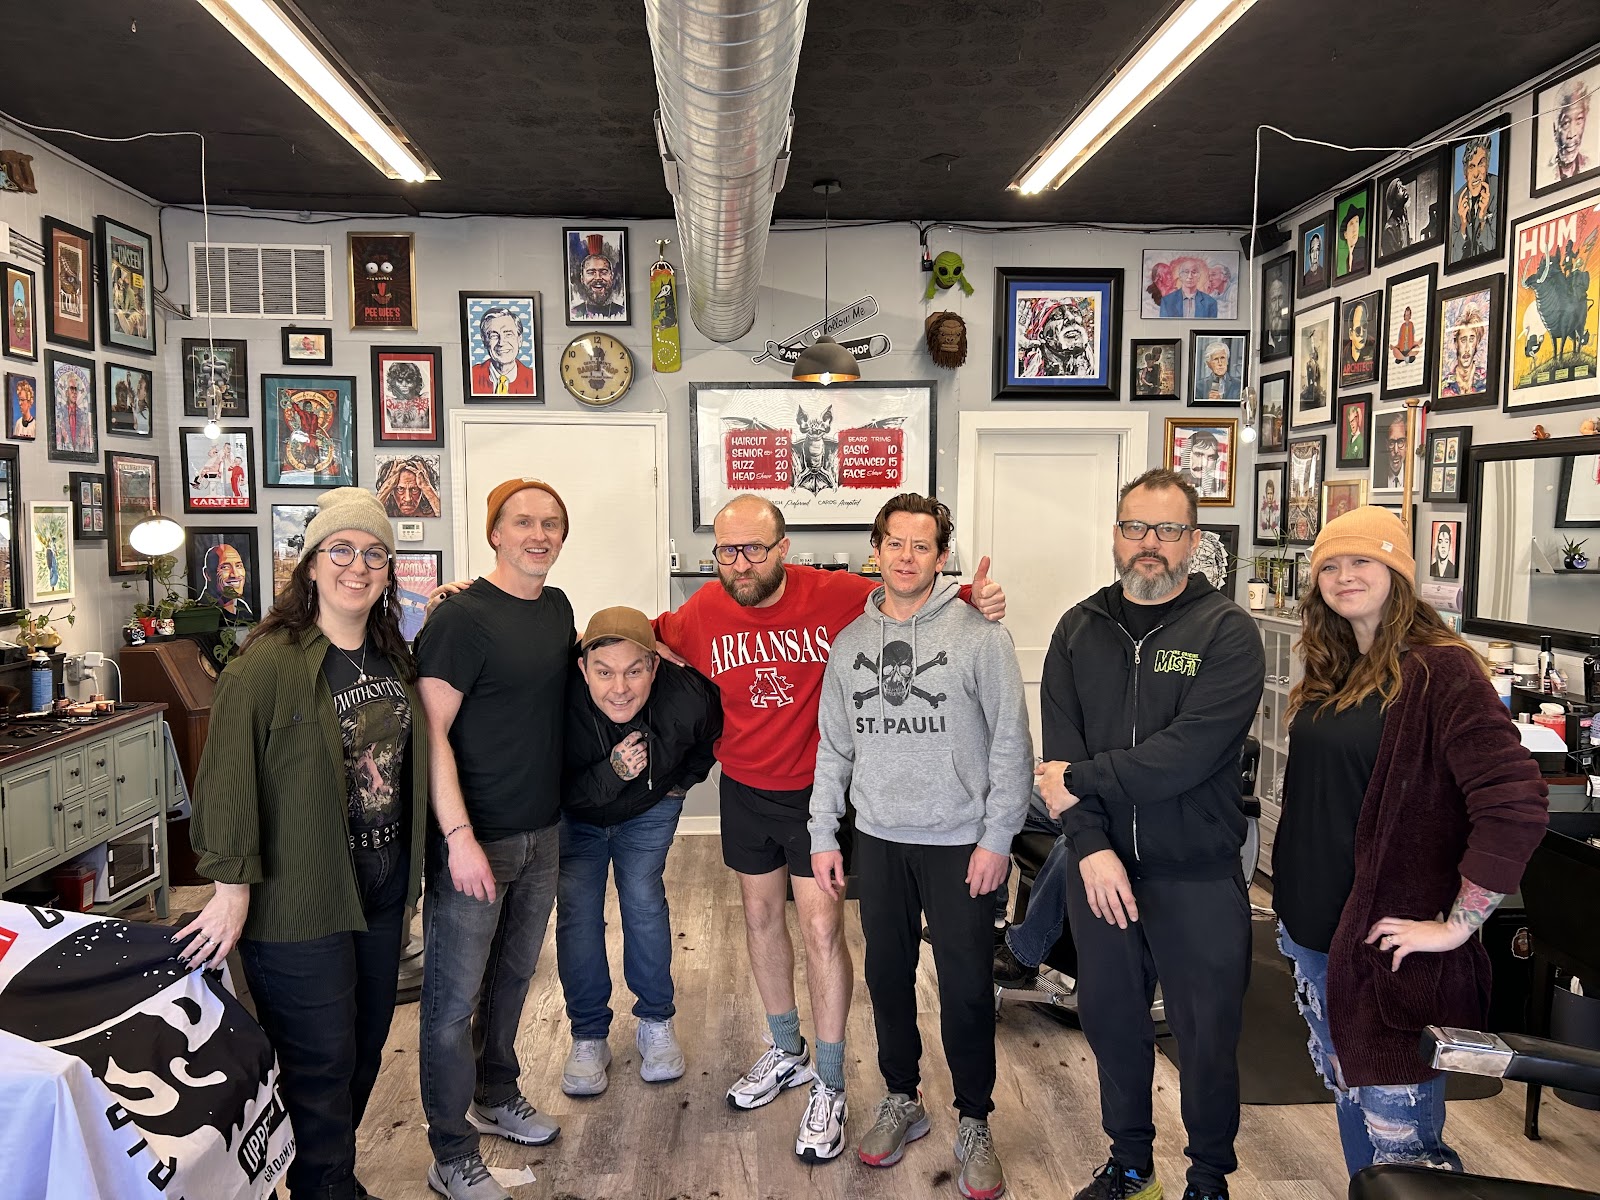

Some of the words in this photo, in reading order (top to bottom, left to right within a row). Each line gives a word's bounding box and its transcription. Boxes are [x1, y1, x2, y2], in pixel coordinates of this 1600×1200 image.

[1520, 214, 1578, 260] HUM
[365, 307, 377, 317] PEE
[852, 307, 866, 320] Me
[1343, 361, 1374, 374] ARCHITECT
[731, 436, 767, 446] HAIRCUT
[775, 436, 788, 446] 25
[731, 448, 763, 458] SENIOR
[774, 448, 788, 458] 20
[843, 445, 869, 454] BASIC
[887, 445, 897, 454] 10
[732, 460, 754, 470] BUZZ
[775, 460, 788, 470] 20
[843, 457, 886, 467] ADVANCED
[888, 457, 898, 467] 15
[732, 472, 755, 481] HEAD
[774, 472, 788, 482] 30
[843, 469, 866, 479] FACE
[885, 469, 898, 479] 30
[837, 499, 862, 509] Accepted
[710, 625, 830, 678] ARKANSAS
[856, 717, 879, 734] ST.
[884, 716, 947, 734] PAULI
